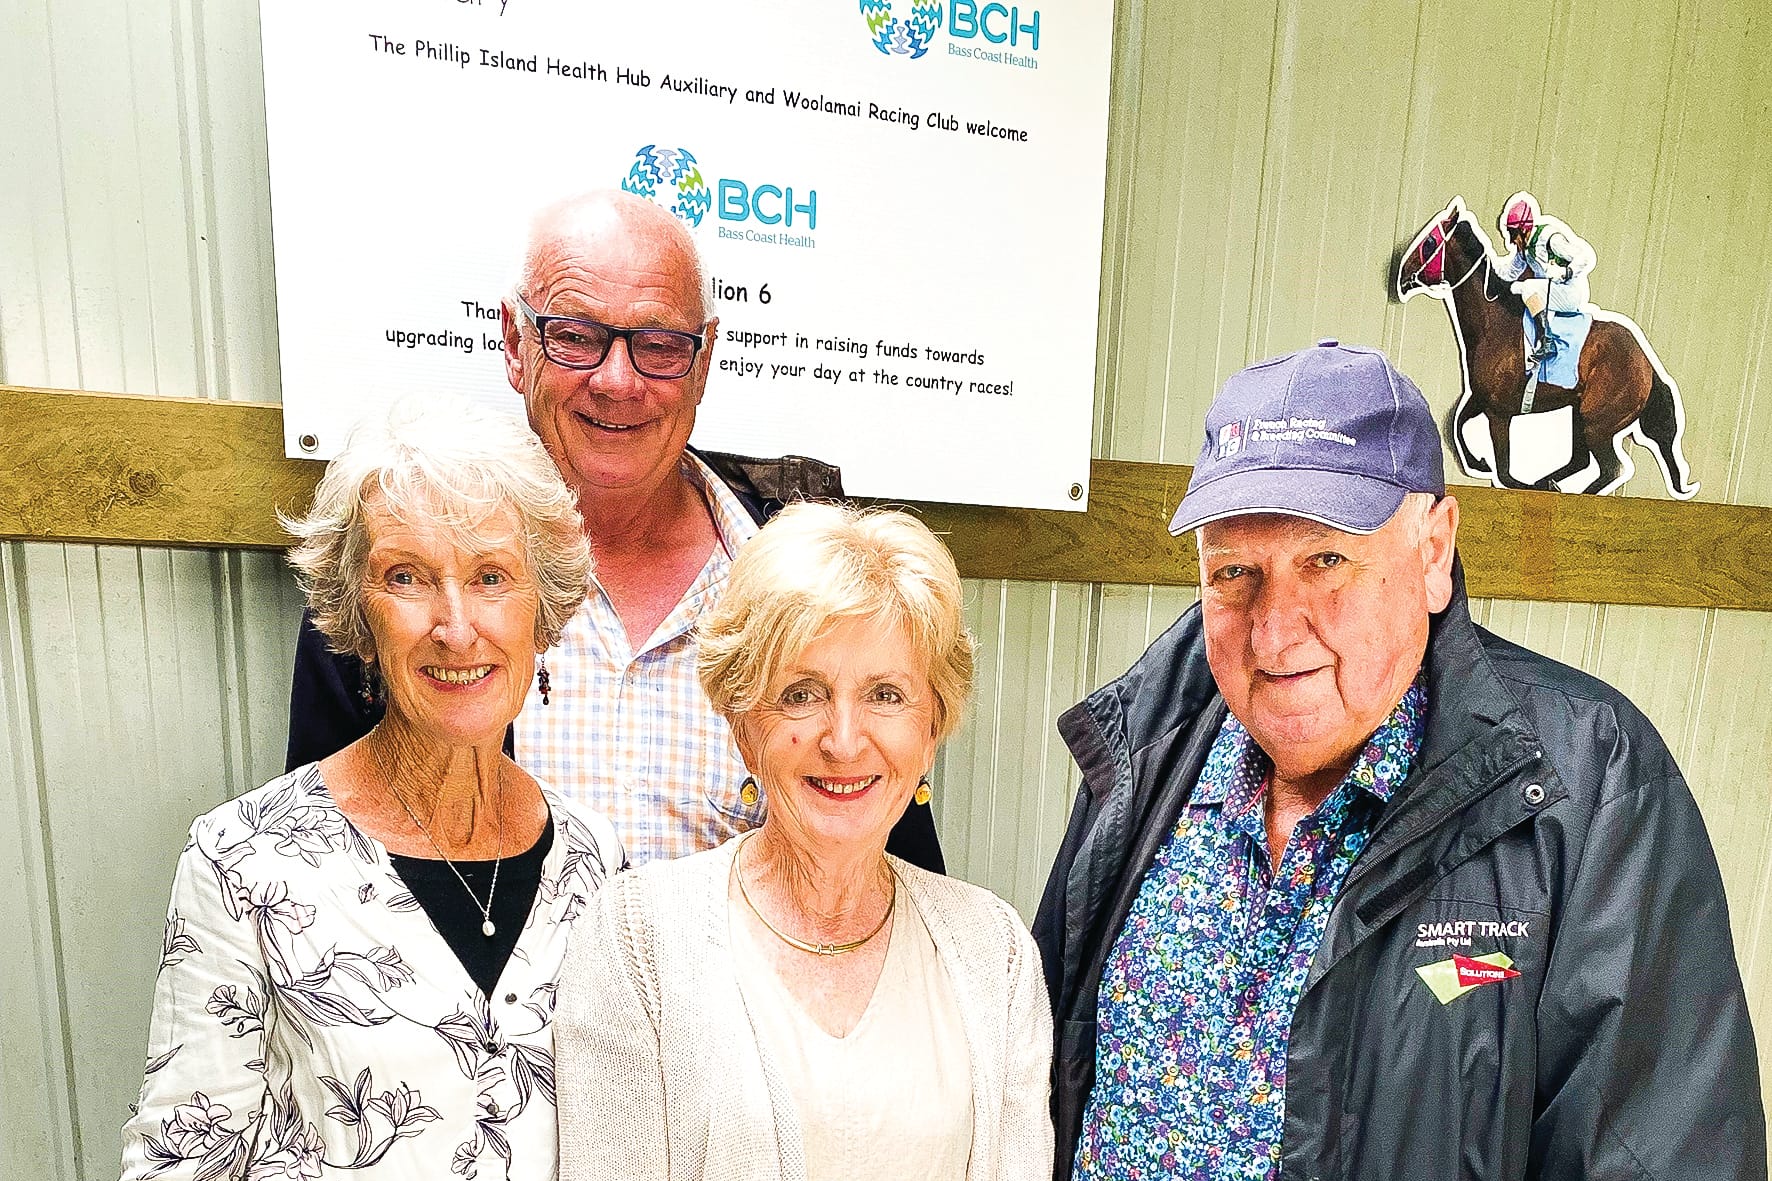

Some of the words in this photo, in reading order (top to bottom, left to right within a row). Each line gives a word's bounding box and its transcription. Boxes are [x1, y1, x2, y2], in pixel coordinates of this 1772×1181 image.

[948, 0, 1040, 51] BCH
[948, 43, 972, 59] Bass
[973, 47, 1002, 65] Coast
[1003, 52, 1038, 70] Health
[369, 34, 405, 55] The
[415, 40, 470, 68] Phillip
[480, 49, 537, 73] Island
[547, 57, 607, 82] Health
[616, 67, 651, 88] Hub
[660, 75, 737, 104] Auxiliary
[746, 88, 774, 105] and
[783, 90, 861, 117] Woolamai
[869, 103, 920, 130] Racing
[926, 113, 959, 132] Club
[966, 120, 1028, 142] welcome
[718, 178, 817, 230] BCH
[718, 226, 744, 241] Bass
[746, 229, 776, 245] Coast
[778, 233, 816, 249] Health
[758, 283, 772, 304] 6
[386, 329, 474, 354] upgrading
[726, 330, 787, 349] support
[796, 333, 809, 349] in
[816, 337, 868, 358] raising
[875, 339, 918, 358] funds
[925, 346, 985, 366] towards
[719, 357, 764, 378] enjoy
[770, 364, 806, 380] your
[813, 363, 842, 385] day
[848, 368, 866, 383] at
[872, 368, 899, 386] the
[905, 375, 963, 396] country
[969, 380, 1014, 397] races!
[1417, 921, 1477, 938] SMART
[1477, 920, 1530, 937] TRACK
